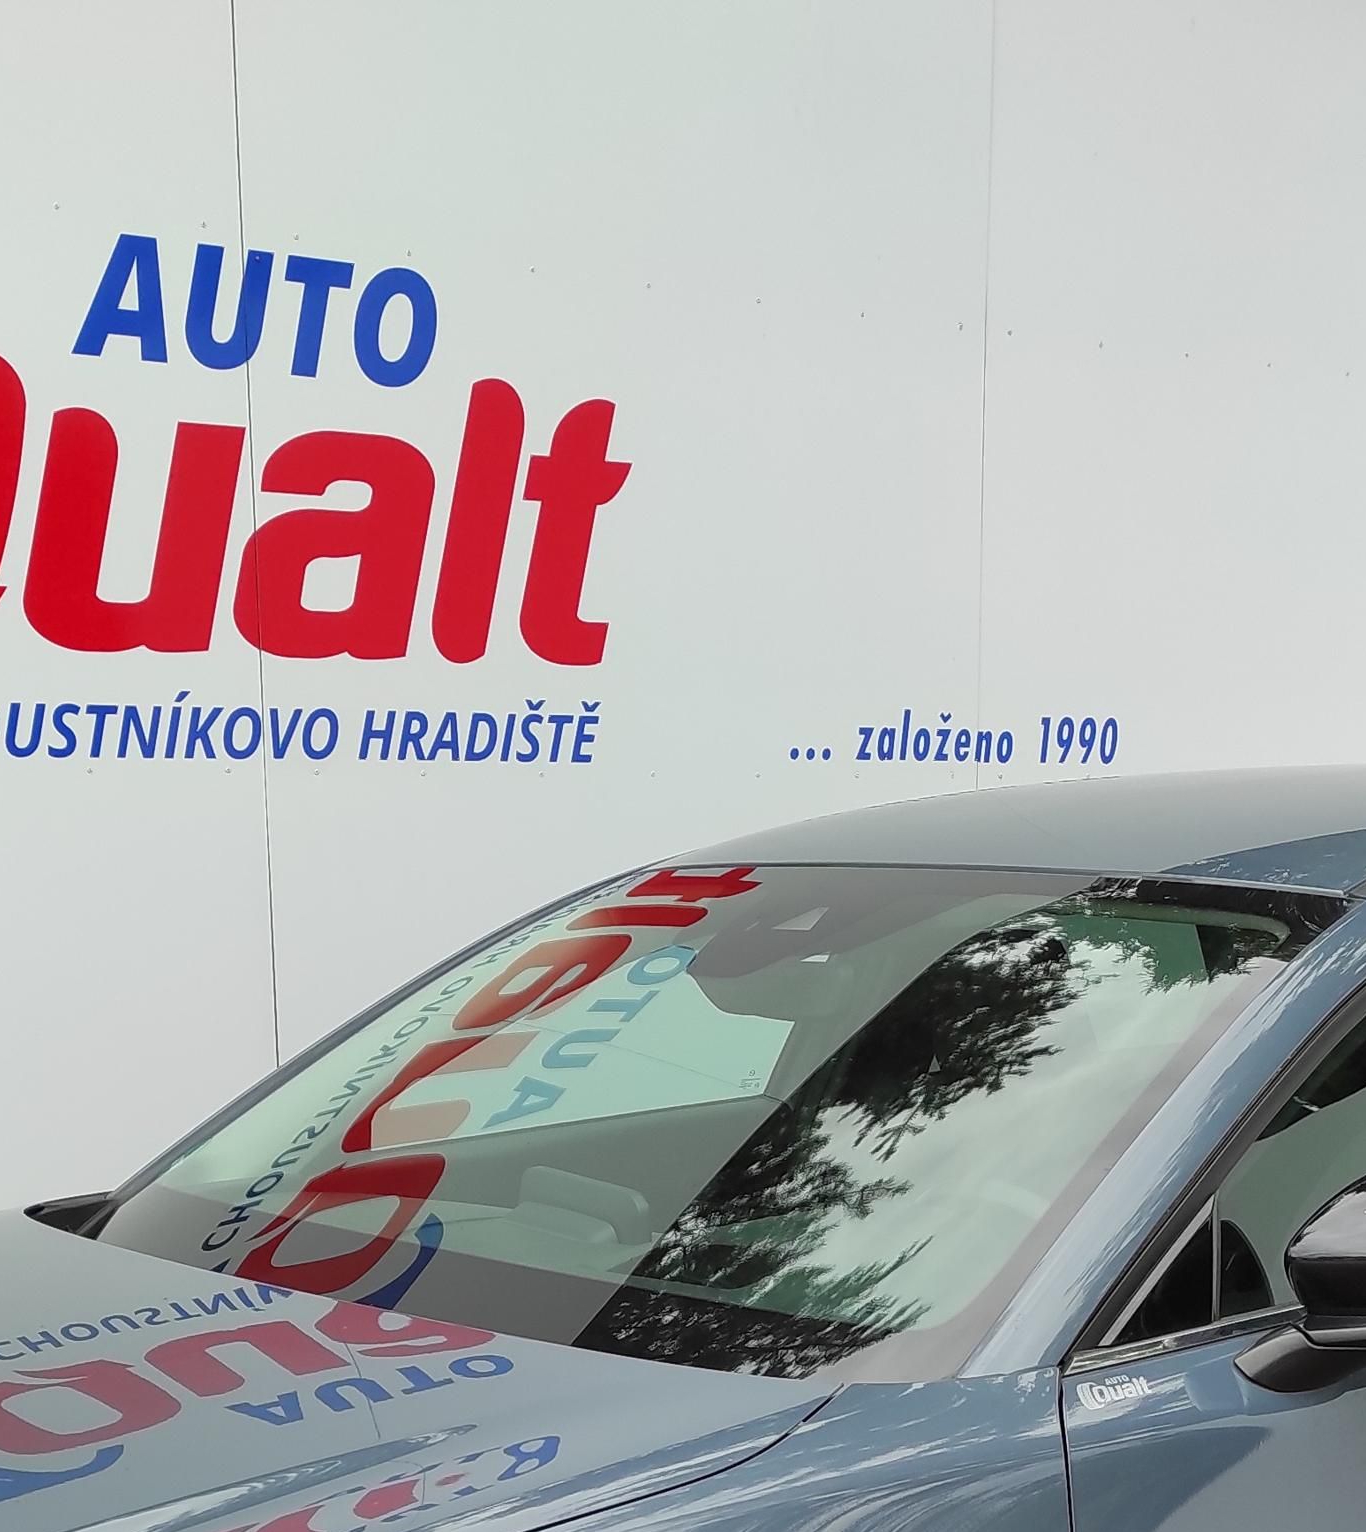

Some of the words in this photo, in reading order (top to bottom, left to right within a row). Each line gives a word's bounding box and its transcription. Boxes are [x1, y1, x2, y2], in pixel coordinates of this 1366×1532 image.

[73, 233, 438, 389] AUTO
[359, 701, 601, 764] HRADIŠTĚ
[856, 709, 1014, 764] založeno
[1040, 717, 1119, 765] 1990
[1092, 1376, 1153, 1401] Qualt
[1104, 1374, 1130, 1386] AUTO
